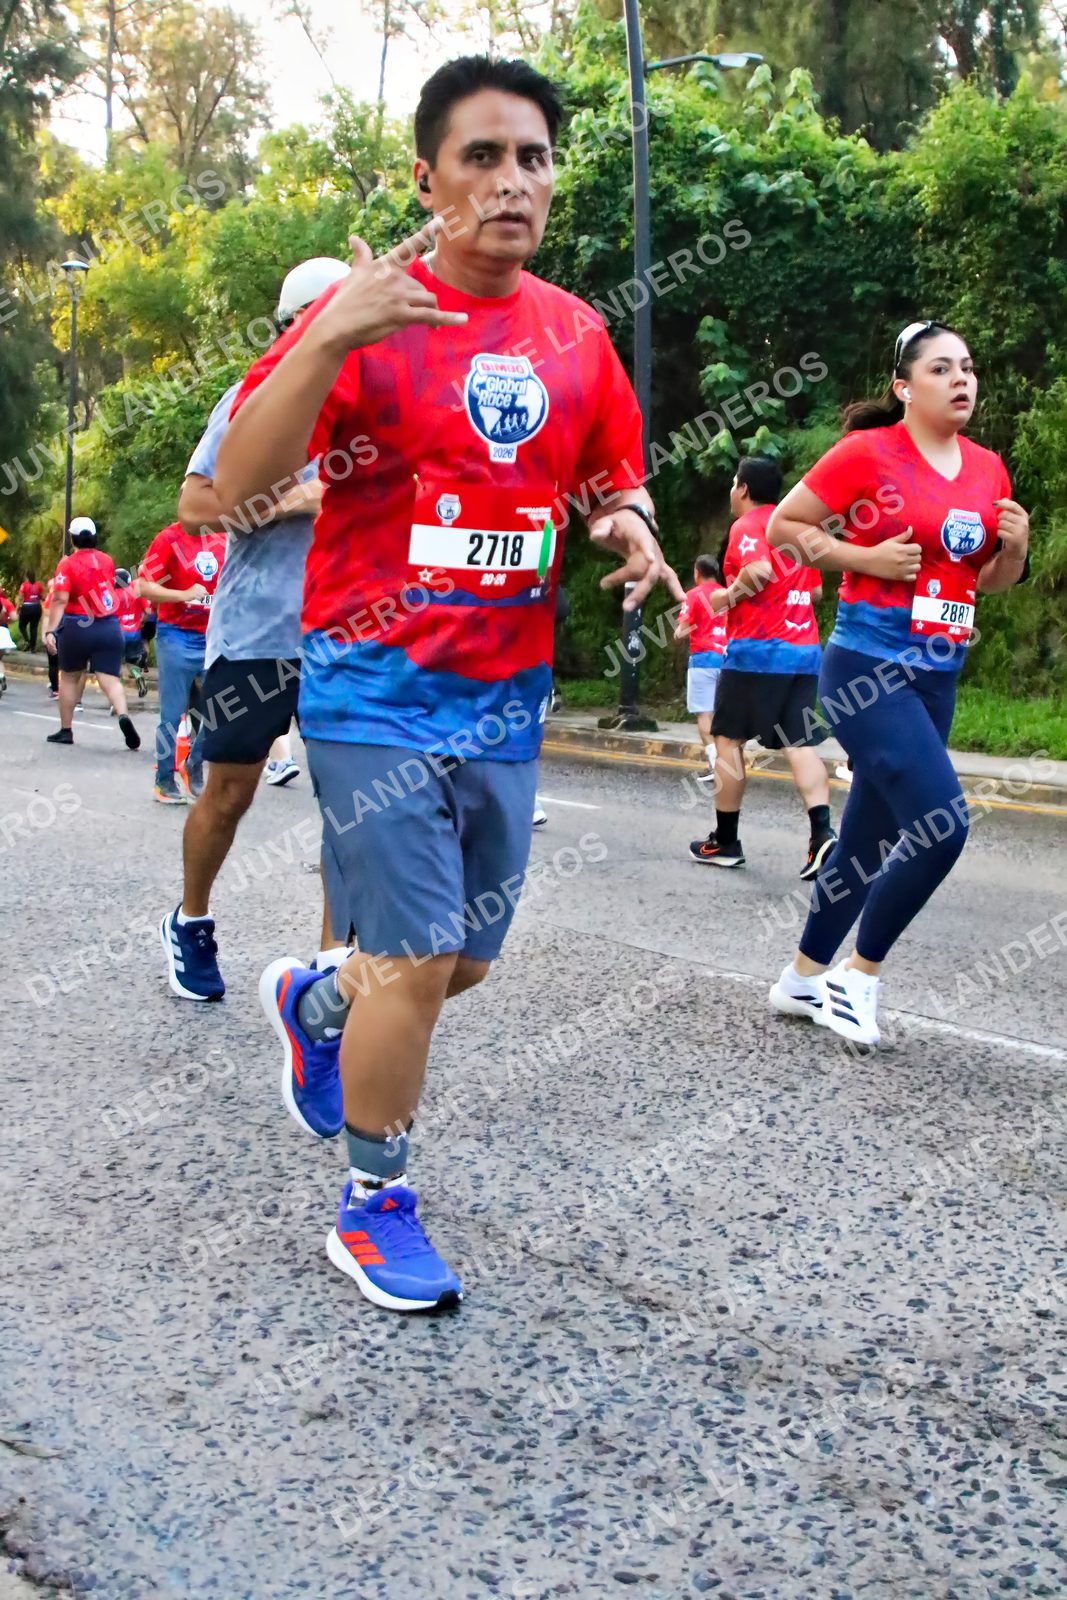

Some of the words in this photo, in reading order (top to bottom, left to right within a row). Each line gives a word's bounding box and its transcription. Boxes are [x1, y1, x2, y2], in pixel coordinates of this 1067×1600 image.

[485, 376, 527, 395] Global
[477, 390, 513, 408] Race
[493, 447, 514, 458] 2026
[467, 533, 524, 566] 2718
[530, 588, 541, 599] 5K
[941, 602, 970, 624] 2887
